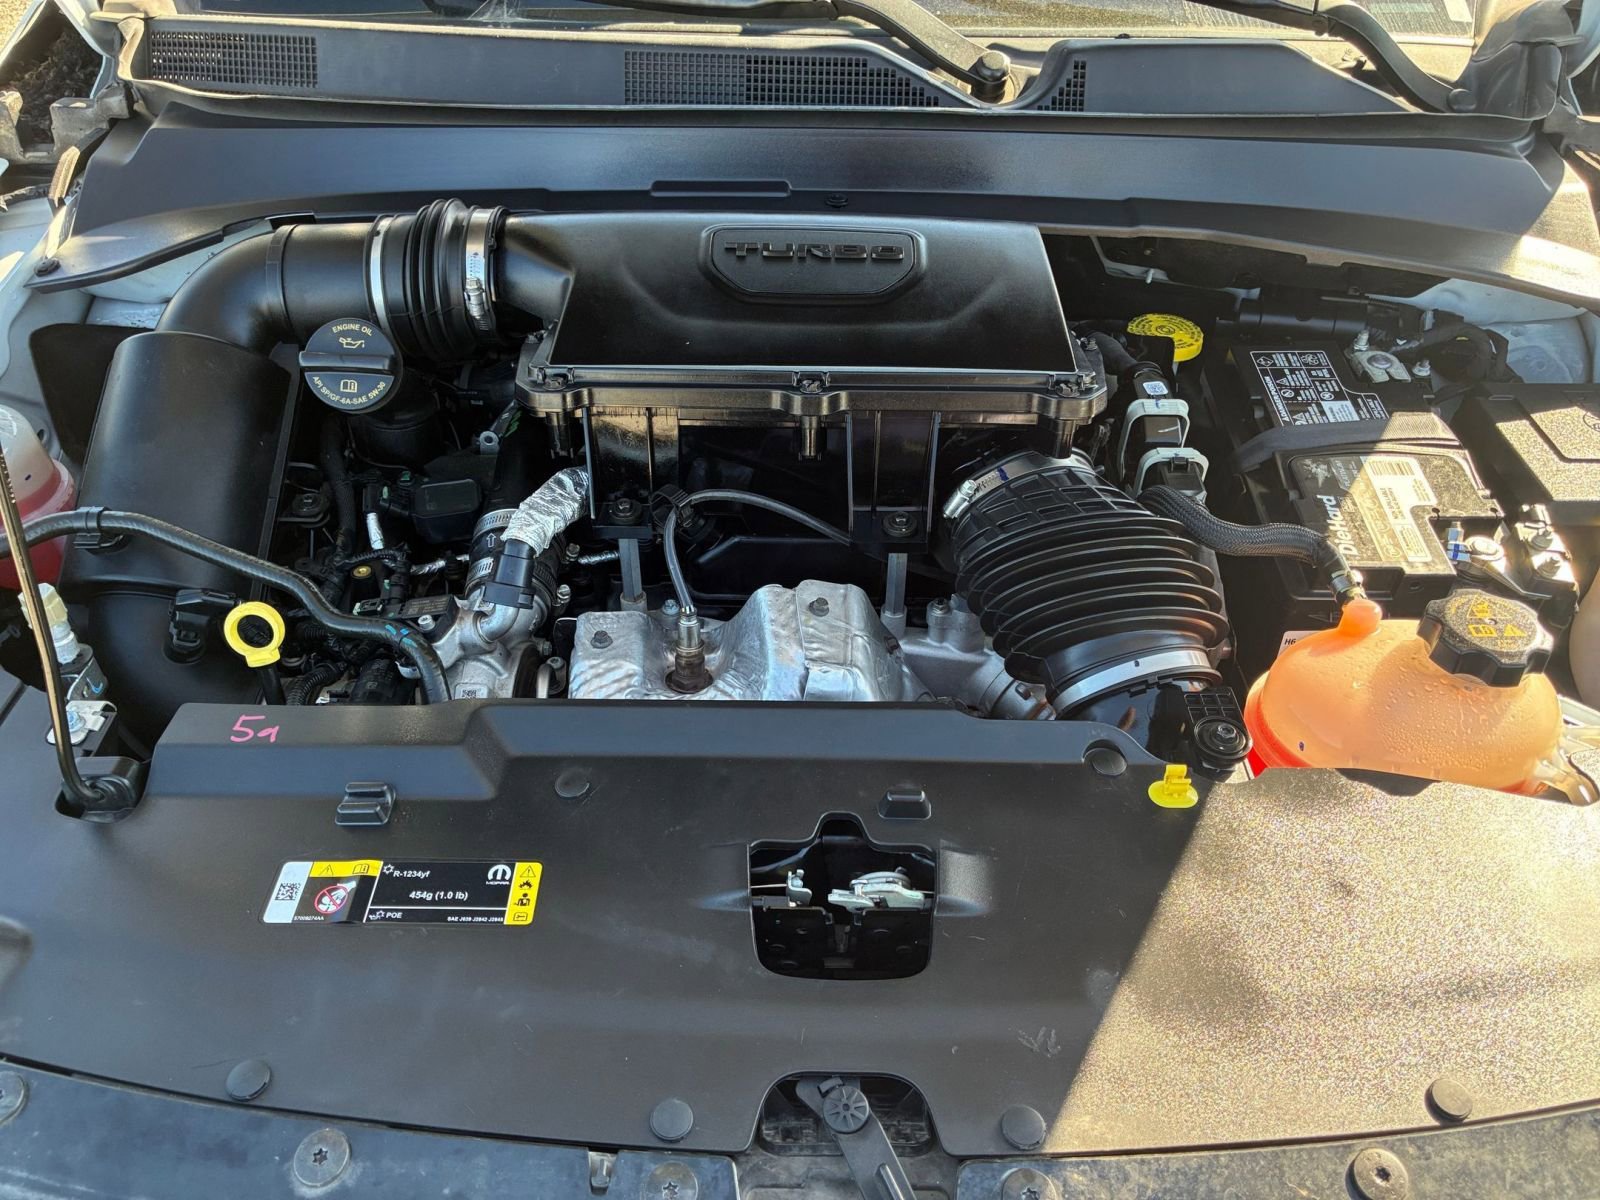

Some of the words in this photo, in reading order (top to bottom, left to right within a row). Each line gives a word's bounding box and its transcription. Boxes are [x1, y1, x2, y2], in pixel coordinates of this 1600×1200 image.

[724, 241, 905, 261] TURBO
[332, 323, 361, 333] ENGINE
[361, 325, 373, 336] OIL
[312, 376, 322, 389] API
[368, 382, 386, 399] 5W-30
[1316, 494, 1360, 556] DieHard
[393, 870, 431, 879] R-1234yf
[409, 891, 433, 901] 454g
[435, 891, 453, 901] (1.0
[455, 891, 469, 901] lb)
